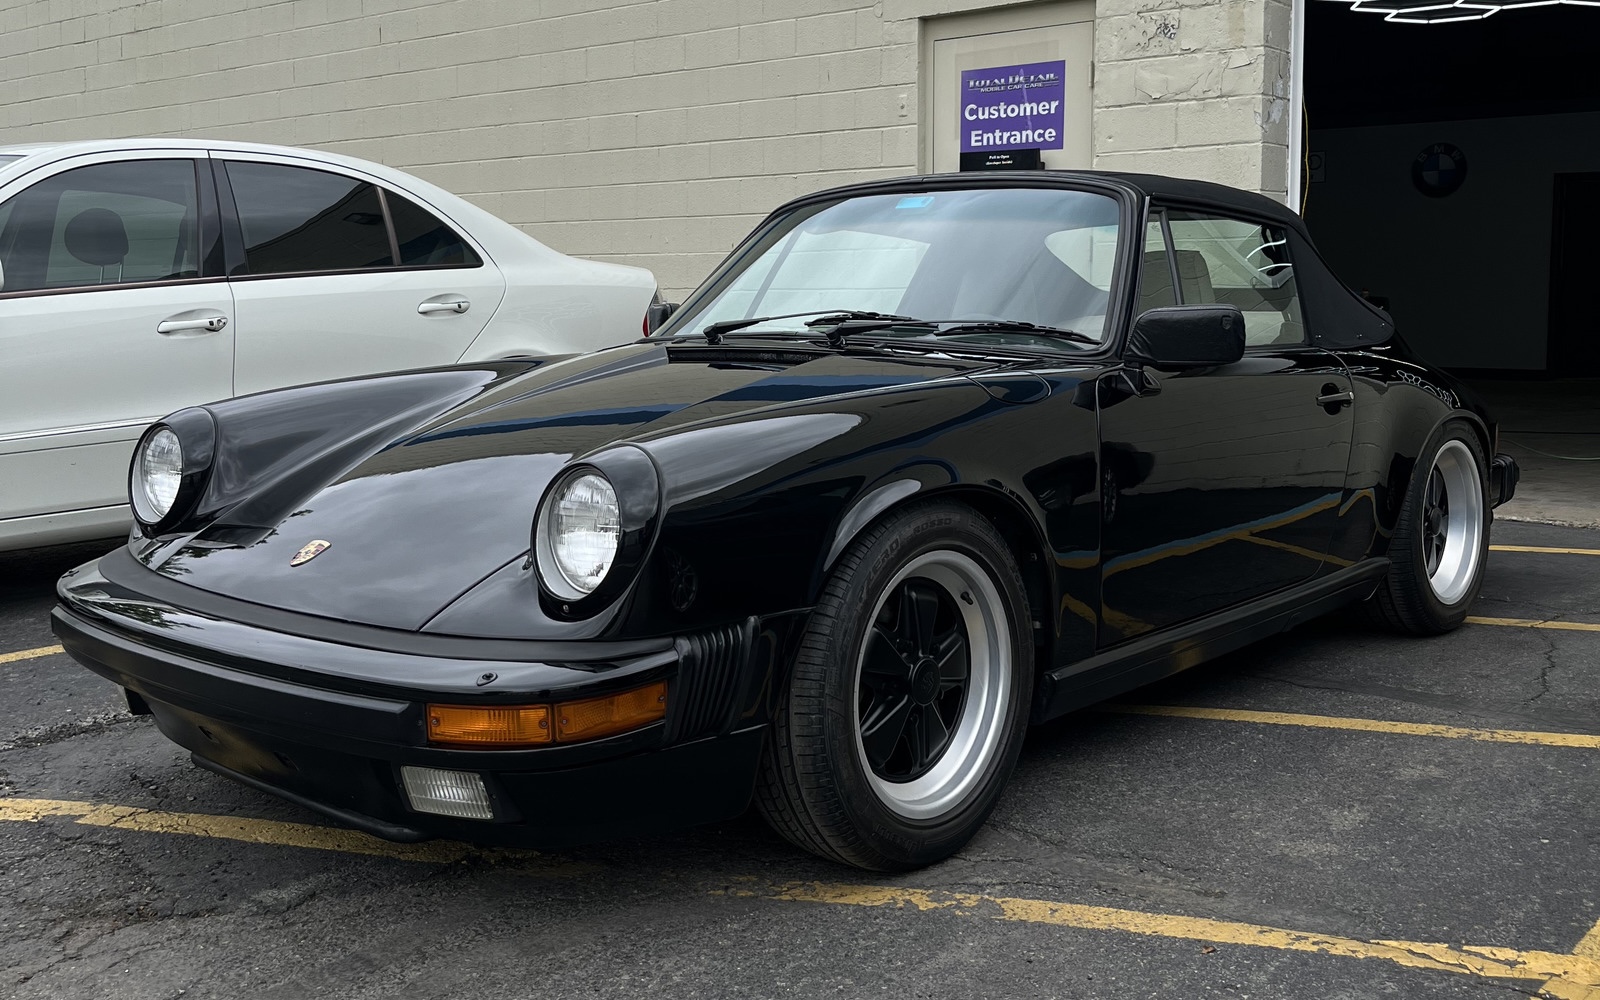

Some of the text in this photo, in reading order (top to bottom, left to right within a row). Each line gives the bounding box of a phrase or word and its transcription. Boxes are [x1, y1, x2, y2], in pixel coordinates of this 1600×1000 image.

[967, 73, 1058, 88] TOTAL DETAIL
[964, 100, 1059, 121] Customer
[970, 128, 1056, 147] Entrance
[1416, 143, 1464, 163] BMW
